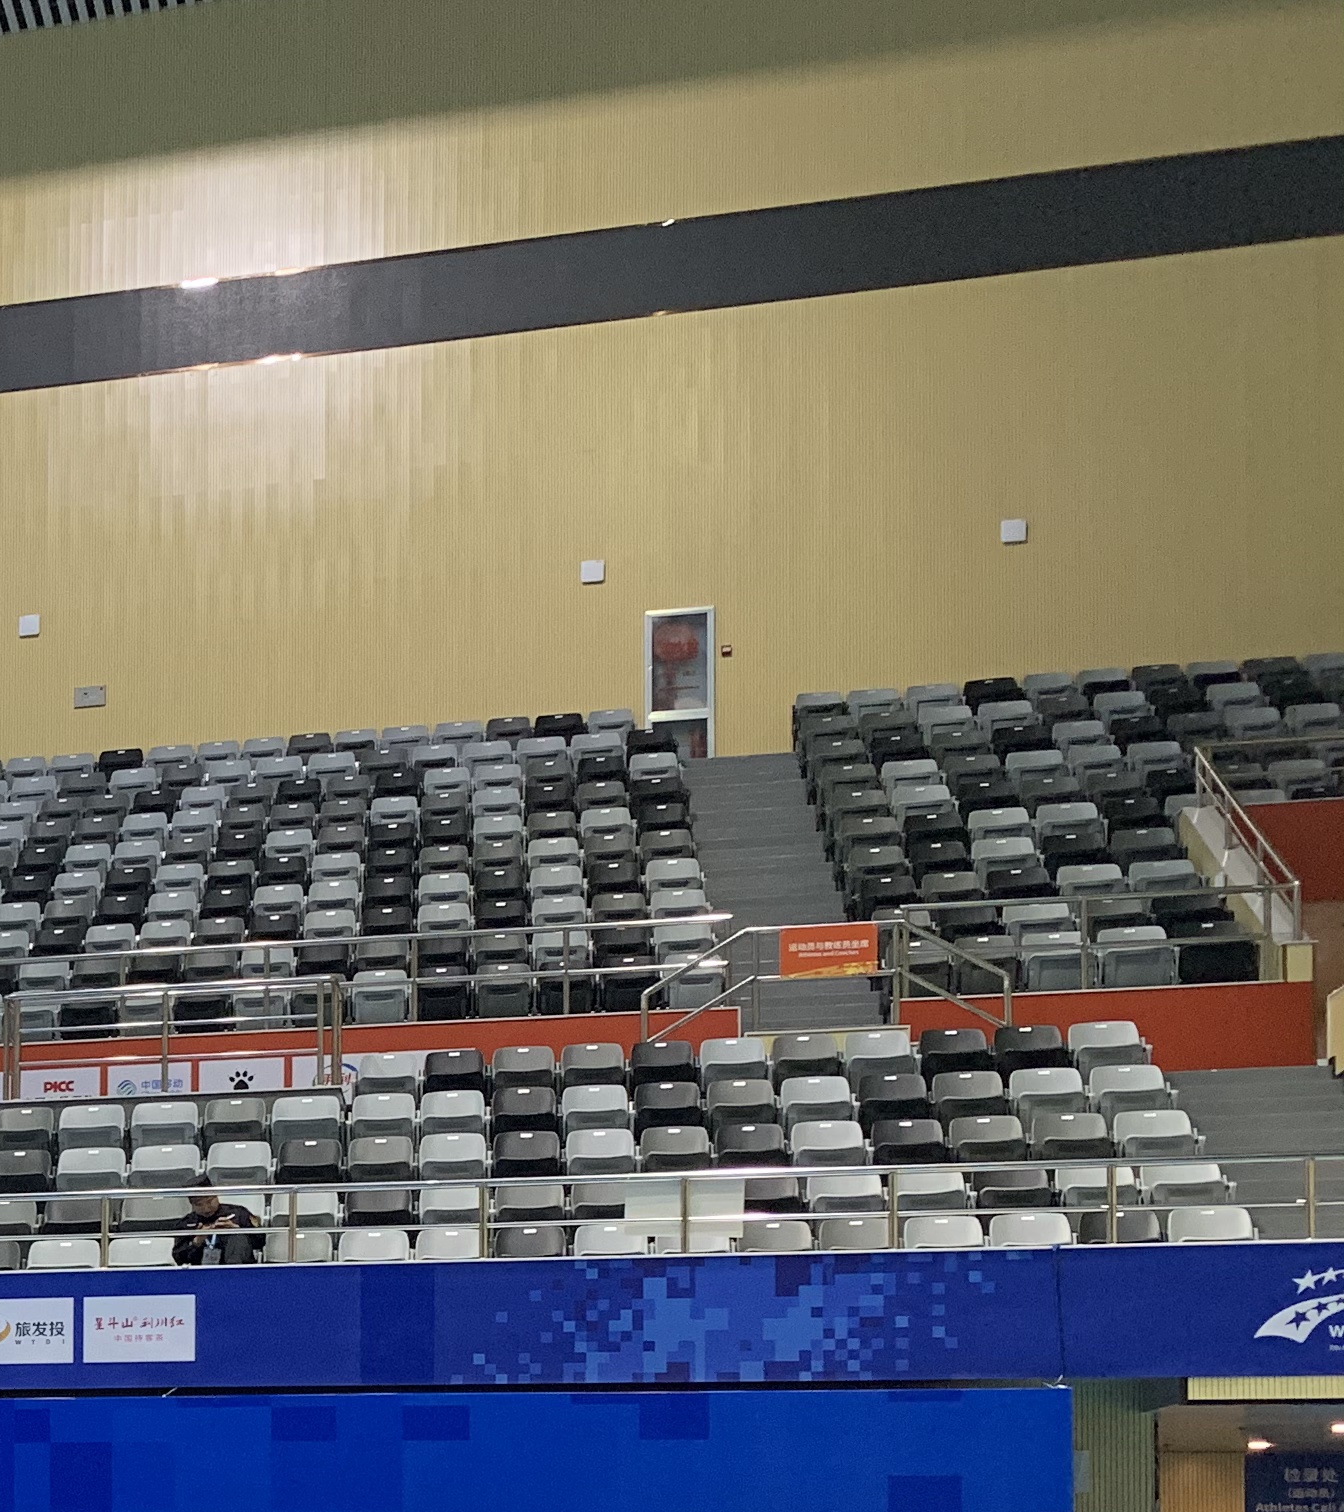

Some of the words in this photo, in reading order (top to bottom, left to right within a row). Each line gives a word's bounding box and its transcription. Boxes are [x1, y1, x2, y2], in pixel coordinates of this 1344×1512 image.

[44, 1081, 74, 1092] PICC
[15, 1321, 65, 1337] 旅发投
